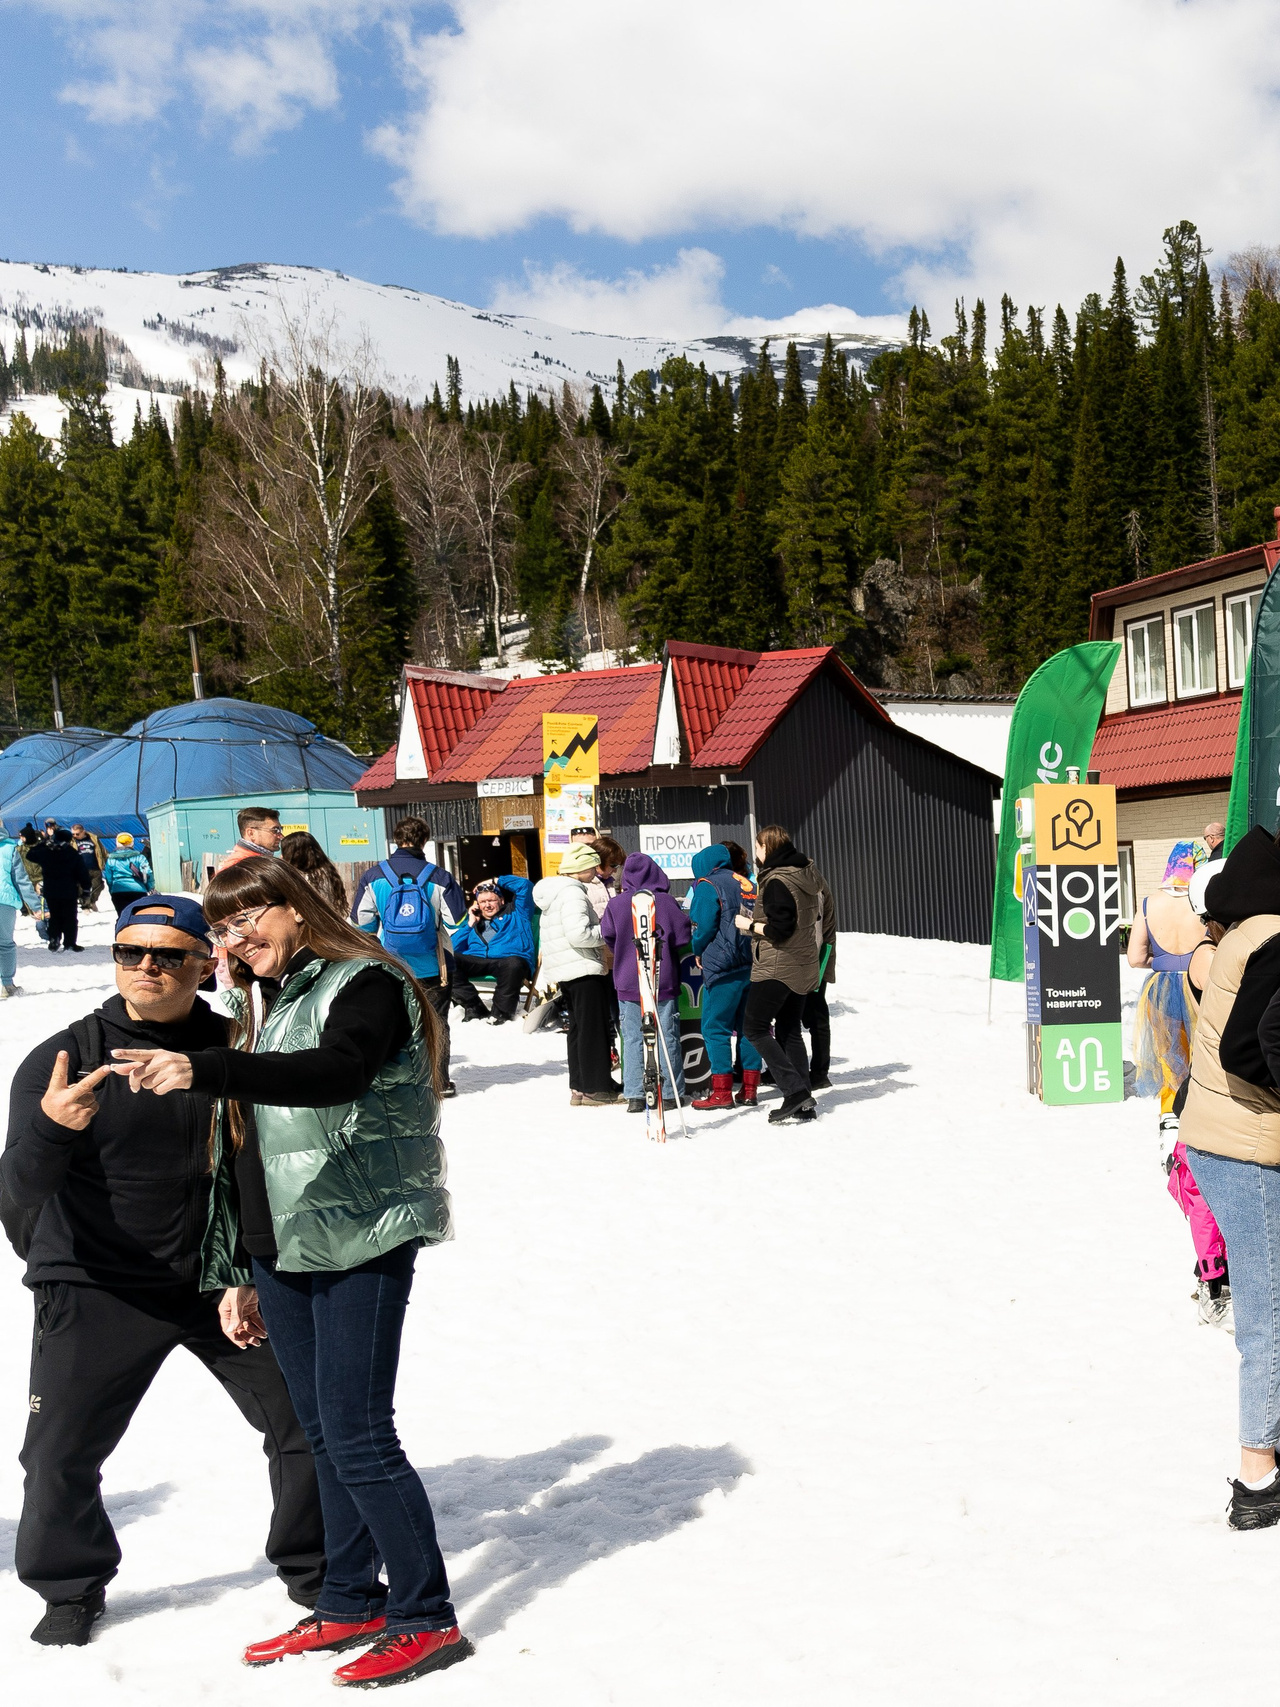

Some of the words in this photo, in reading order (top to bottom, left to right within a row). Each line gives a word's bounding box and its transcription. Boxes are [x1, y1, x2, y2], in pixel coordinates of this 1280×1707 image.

[482, 780, 528, 794] СЕРВИС
[646, 834, 705, 850] ПРОКАТ
[653, 854, 668, 867] ОТ
[640, 914, 650, 971] HEAD
[1045, 987, 1087, 998] Точный
[1046, 999, 1102, 1009] навигатор
[1056, 1038, 1076, 1060] А
[1093, 1070, 1111, 1092] Б
